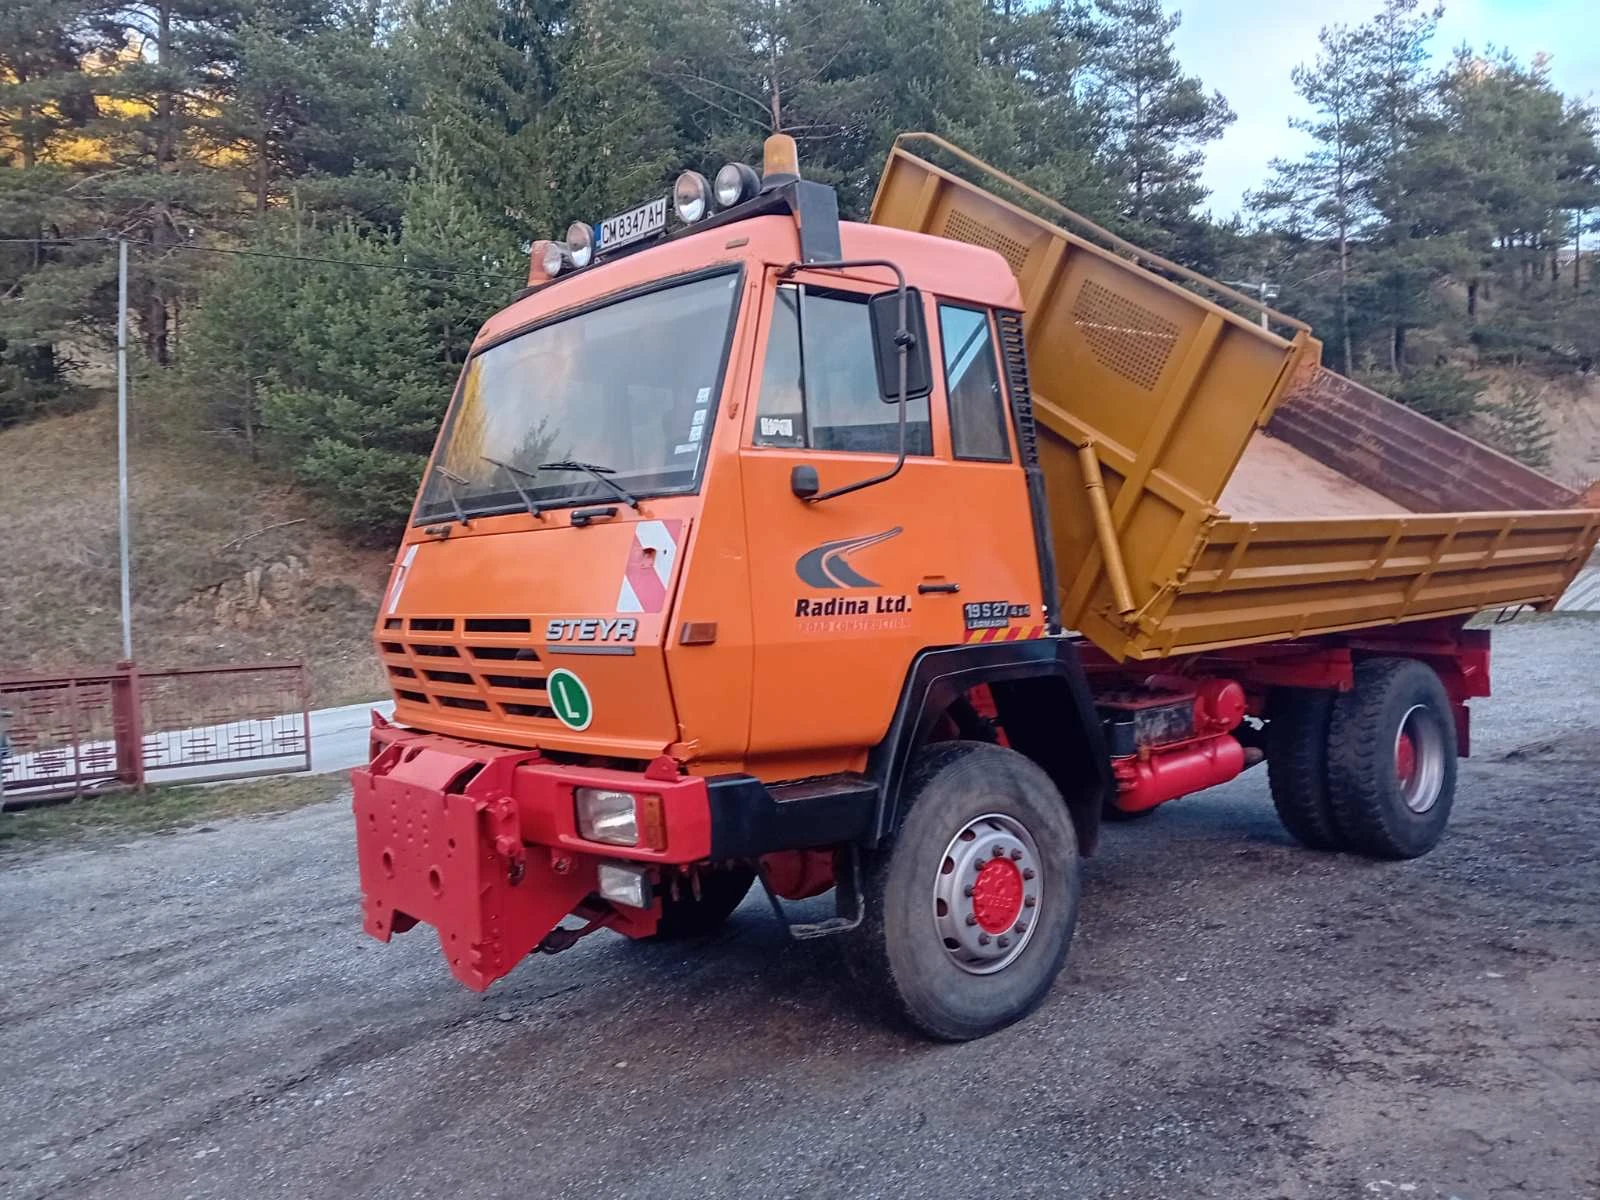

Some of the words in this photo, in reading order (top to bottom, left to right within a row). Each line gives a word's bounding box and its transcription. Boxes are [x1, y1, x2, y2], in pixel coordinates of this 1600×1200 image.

[602, 222, 617, 243] CM
[619, 209, 646, 238] 8347
[648, 201, 664, 227] AH
[795, 598, 869, 617] Radina
[876, 595, 912, 613] Ltd.
[545, 618, 638, 642] STEYR
[558, 681, 580, 719] L
